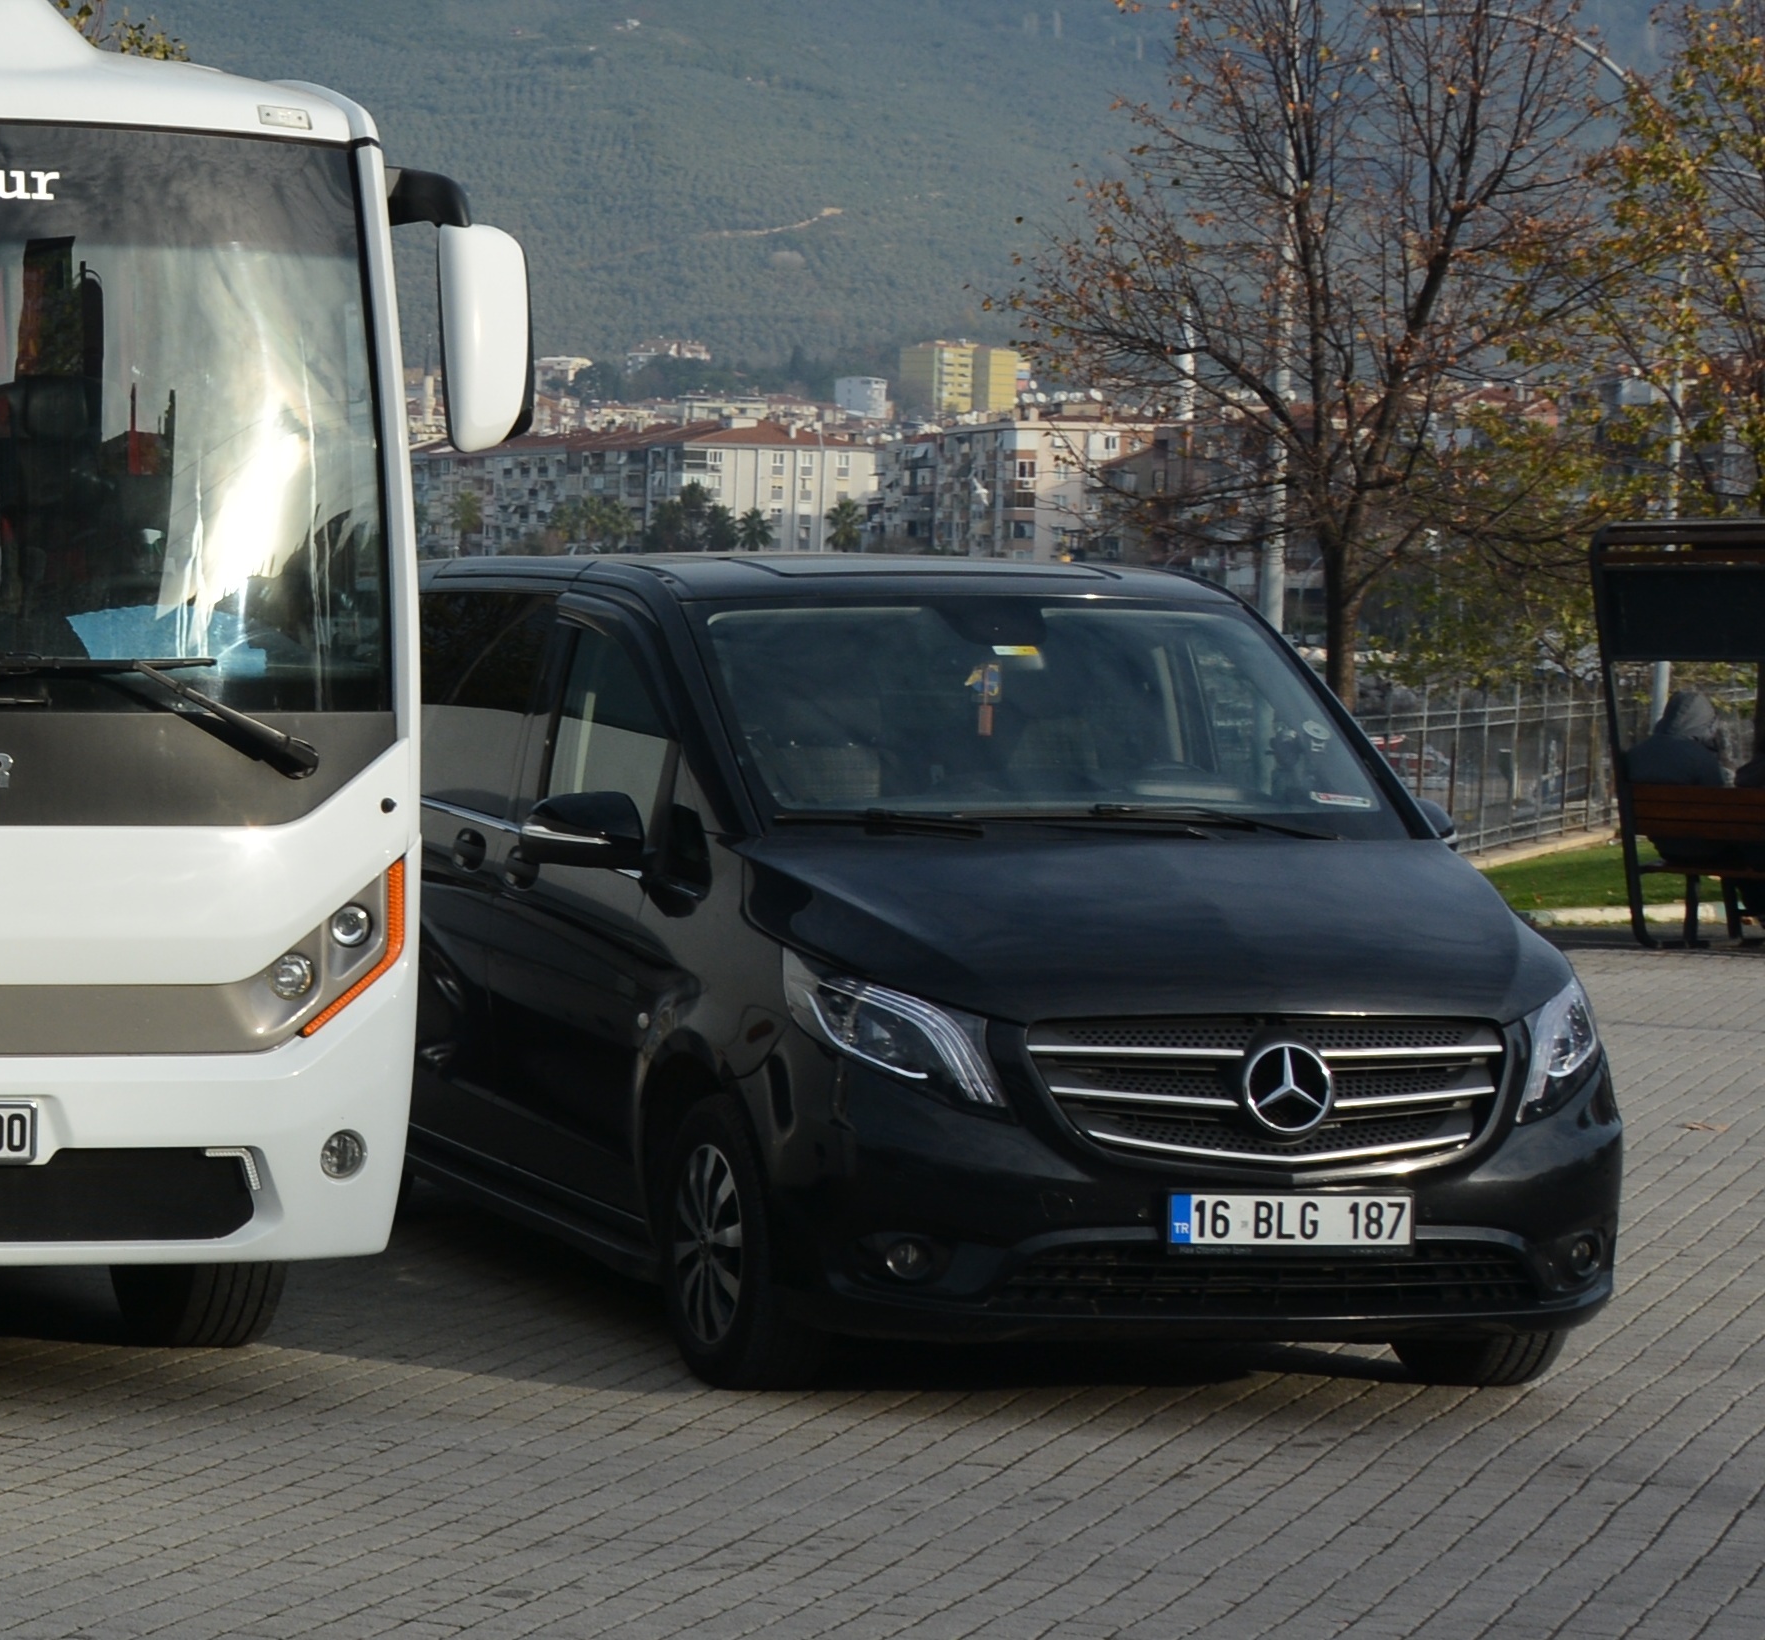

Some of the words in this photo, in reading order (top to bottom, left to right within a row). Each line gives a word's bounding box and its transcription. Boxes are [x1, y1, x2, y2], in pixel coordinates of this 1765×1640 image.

[1173, 1222, 1190, 1234] TR
[1194, 1199, 1231, 1240] 16
[1253, 1200, 1320, 1240] BLG
[1347, 1200, 1407, 1240] 187
